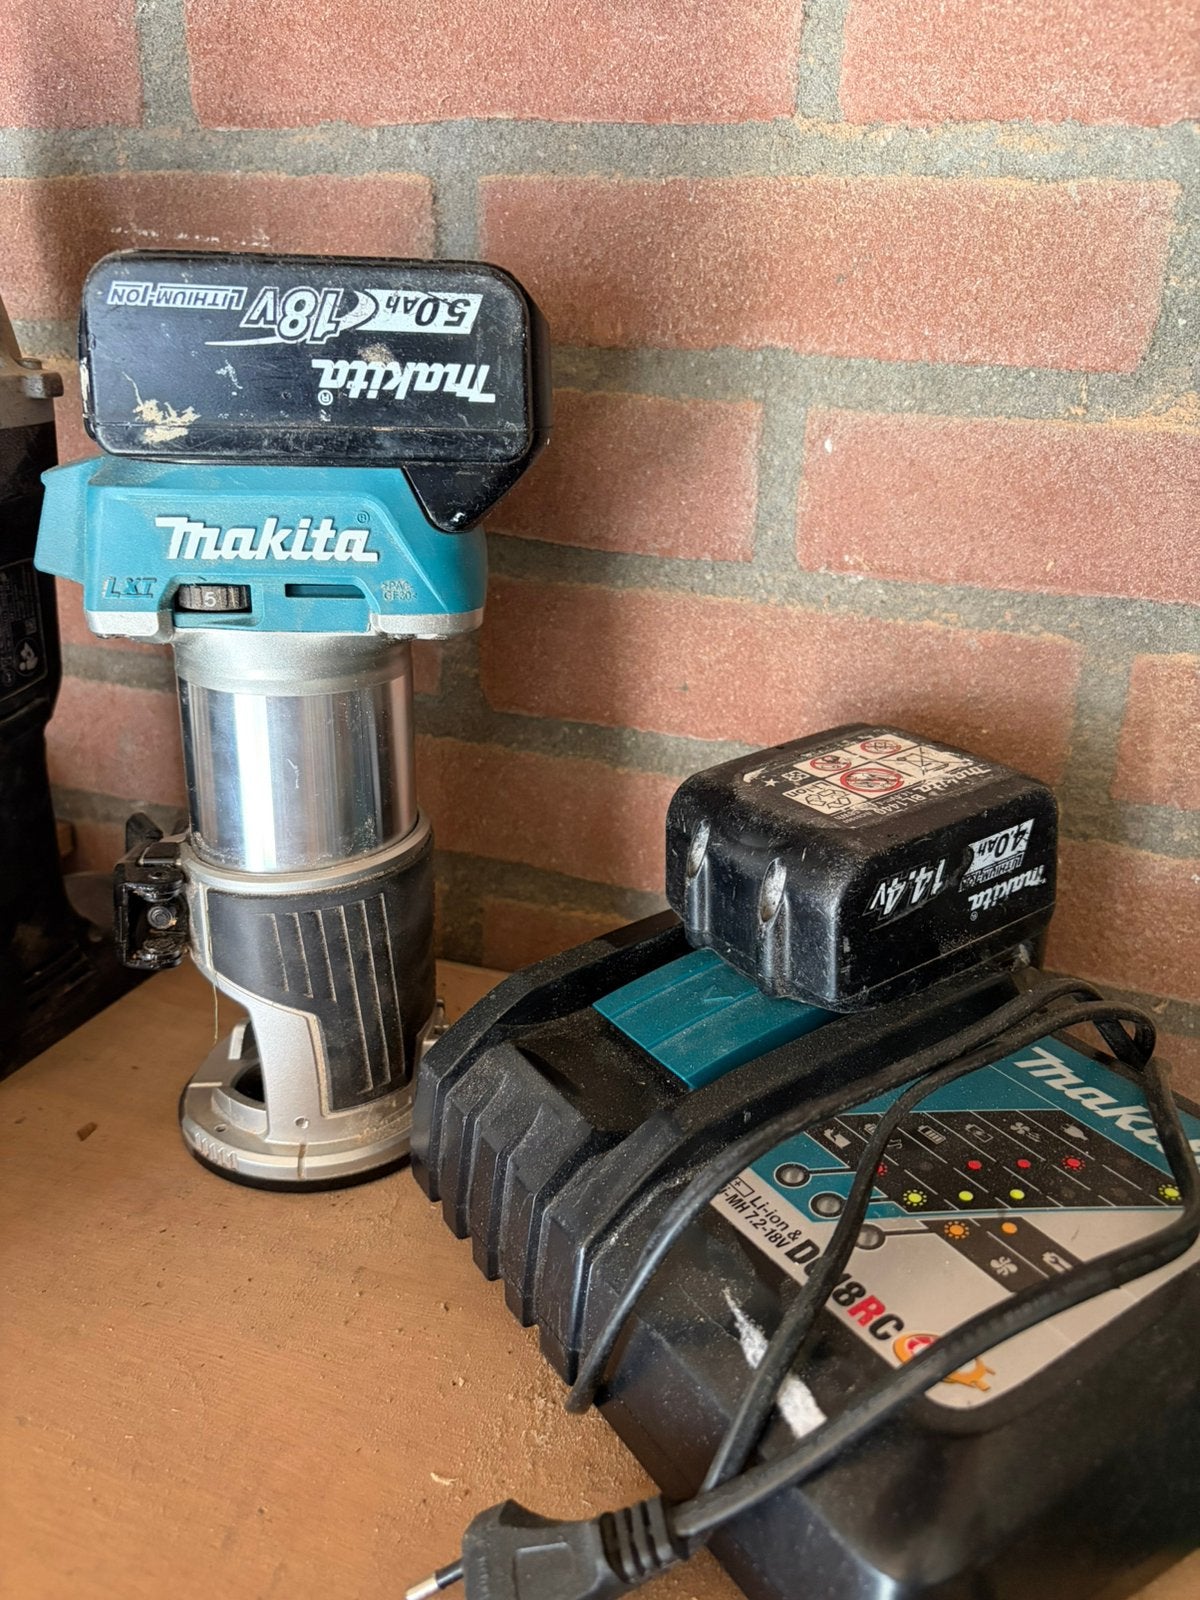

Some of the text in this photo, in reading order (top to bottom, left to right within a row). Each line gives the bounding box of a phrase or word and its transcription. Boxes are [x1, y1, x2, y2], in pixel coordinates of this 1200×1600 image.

[107, 281, 248, 311] LITHIUM-ION
[241, 286, 344, 345] 18V
[104, 576, 157, 599] LXT
[204, 591, 216, 607] 5
[867, 858, 947, 916] 14.4V
[719, 1186, 791, 1248] i-MH 7.2-18V
[749, 1195, 802, 1242] Li-ion &
